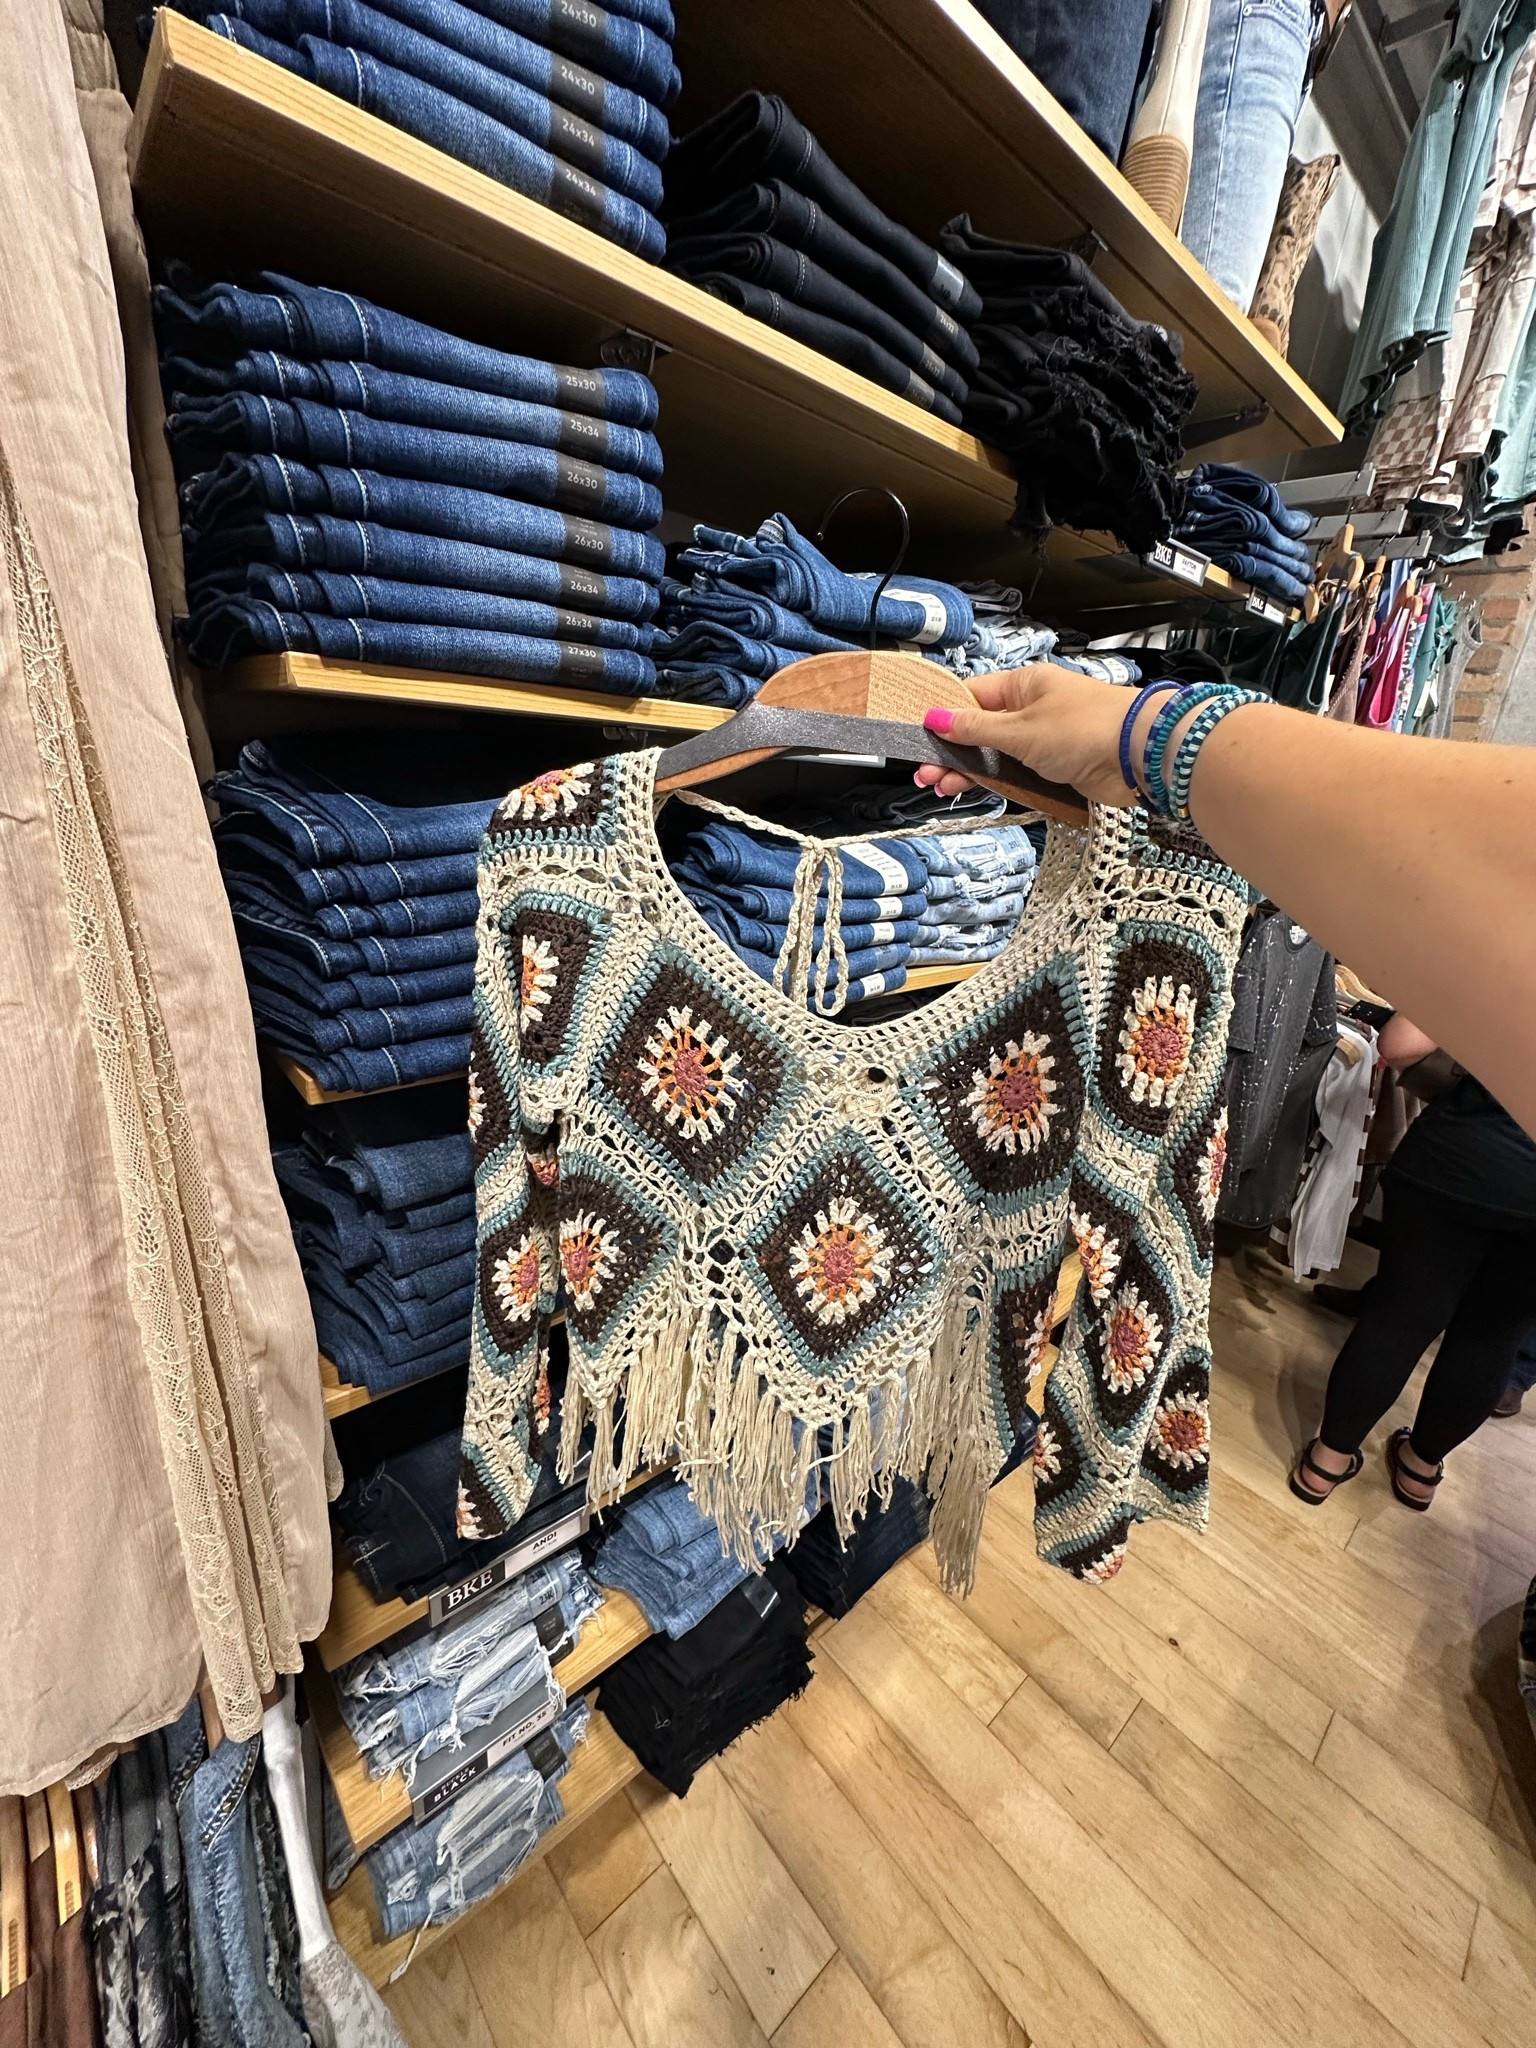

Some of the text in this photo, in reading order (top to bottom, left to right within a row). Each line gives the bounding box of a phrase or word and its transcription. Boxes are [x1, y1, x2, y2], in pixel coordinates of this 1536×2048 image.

[561, 1, 597, 27] 24x30
[561, 66, 595, 95] 24x30
[562, 118, 595, 147] 24x34
[564, 169, 597, 197] 24x34
[566, 375, 597, 392] 25x30
[570, 419, 600, 438] 25x34
[567, 471, 598, 489] 26x30
[574, 534, 604, 551] 26x30
[1154, 542, 1173, 566] BKE
[570, 580, 599, 595] 26x34
[565, 615, 593, 629] 26x34
[567, 646, 597, 658] 27x30
[532, 1531, 558, 1550] ANDI
[447, 1569, 493, 1610] BKE
[502, 1734, 517, 1747] FIT
[518, 1721, 535, 1733] NO.
[434, 1766, 477, 1803] BLACK
